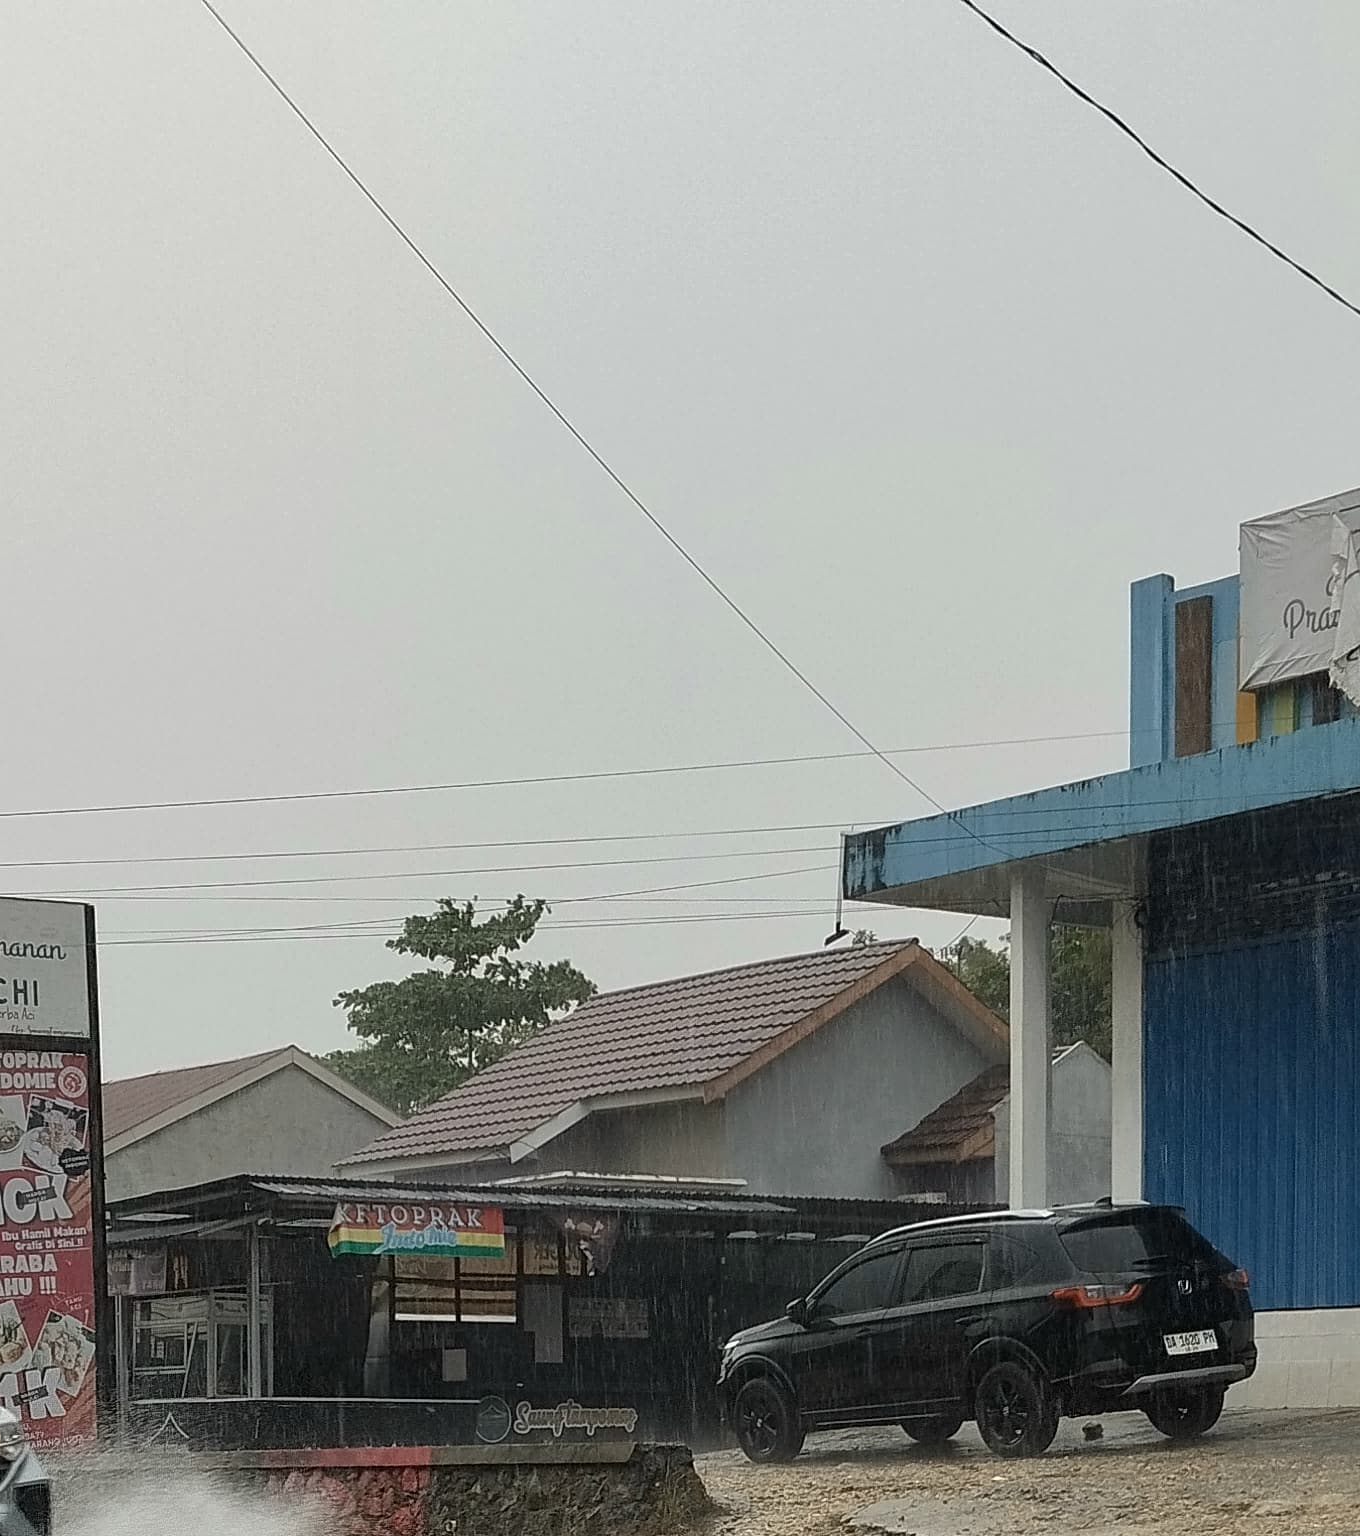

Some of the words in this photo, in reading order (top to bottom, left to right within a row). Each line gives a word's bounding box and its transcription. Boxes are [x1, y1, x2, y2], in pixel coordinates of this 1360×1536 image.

[336, 1202, 482, 1228] KETOPRAK
[21, 1227, 50, 1240] Hamil
[53, 1225, 87, 1238] Makan
[45, 1240, 55, 1249] Di
[39, 1276, 57, 1294] !!!
